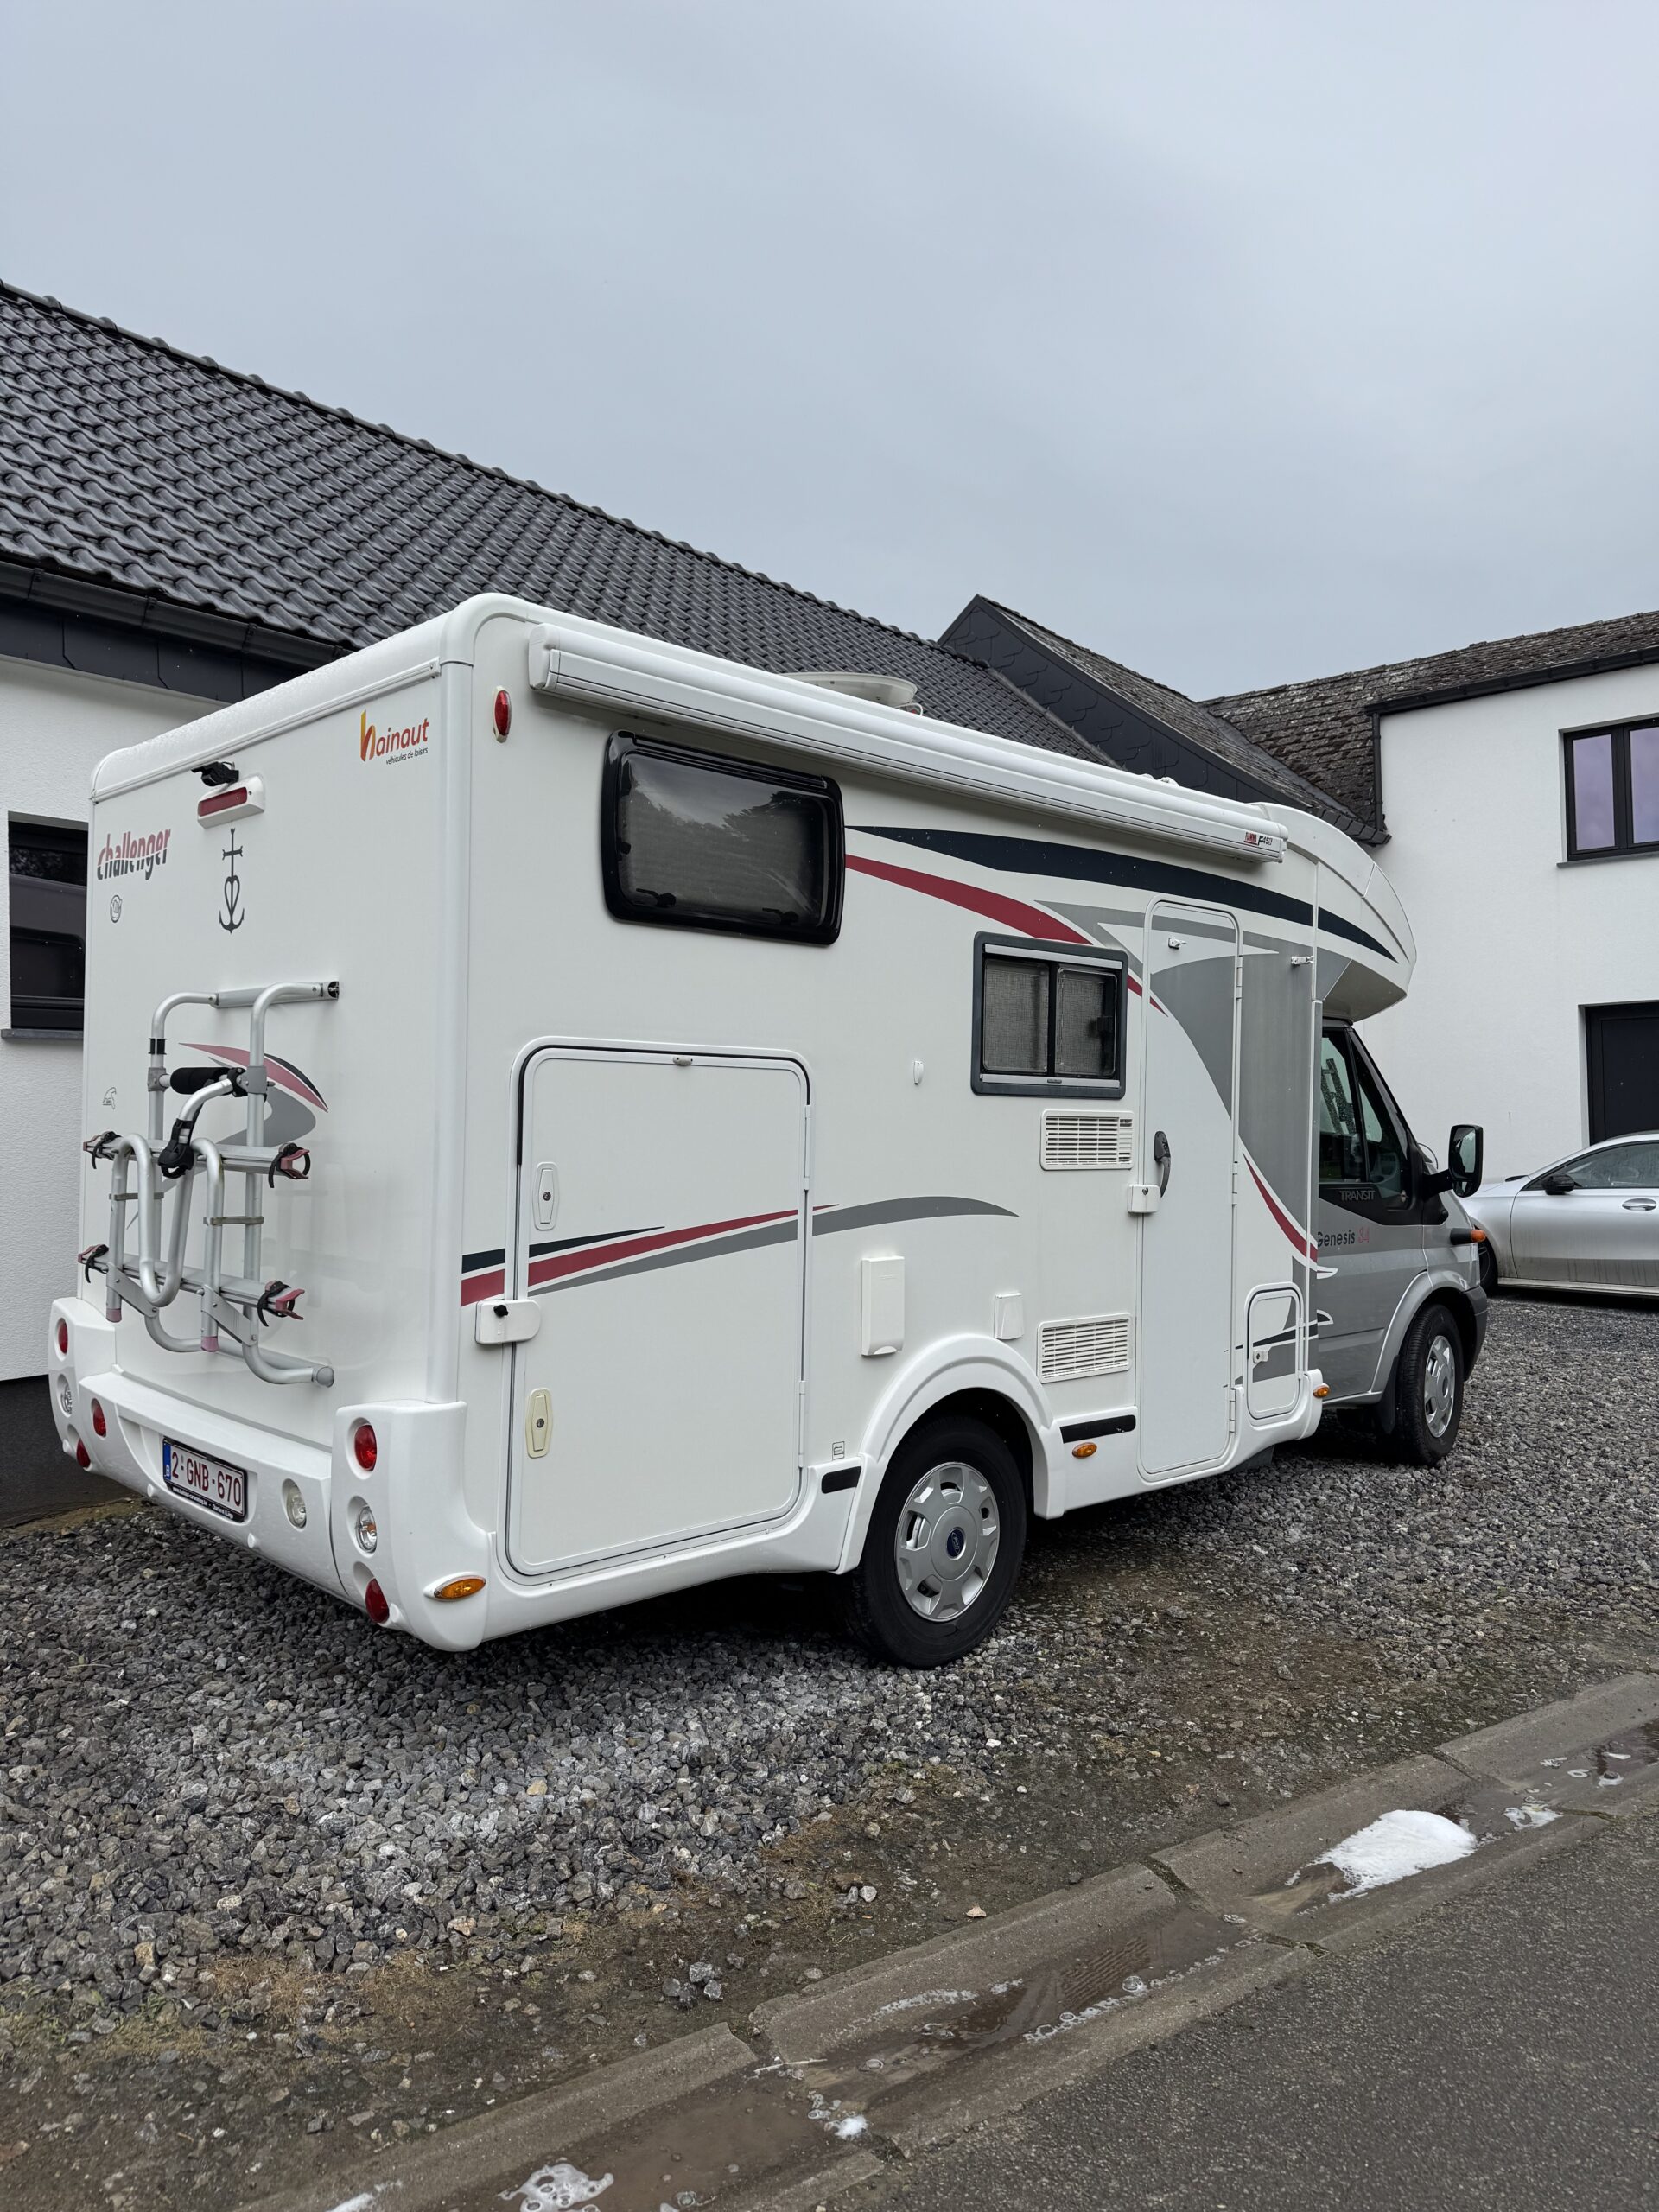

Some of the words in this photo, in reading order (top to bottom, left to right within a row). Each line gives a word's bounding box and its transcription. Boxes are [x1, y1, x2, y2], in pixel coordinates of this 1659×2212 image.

[360, 709, 429, 762] hainaut
[407, 750, 414, 760] de
[414, 747, 429, 757] loisirs
[97, 829, 171, 880] challenger
[1339, 1190, 1376, 1201] TRANSIT
[1317, 1230, 1356, 1247] Genesis
